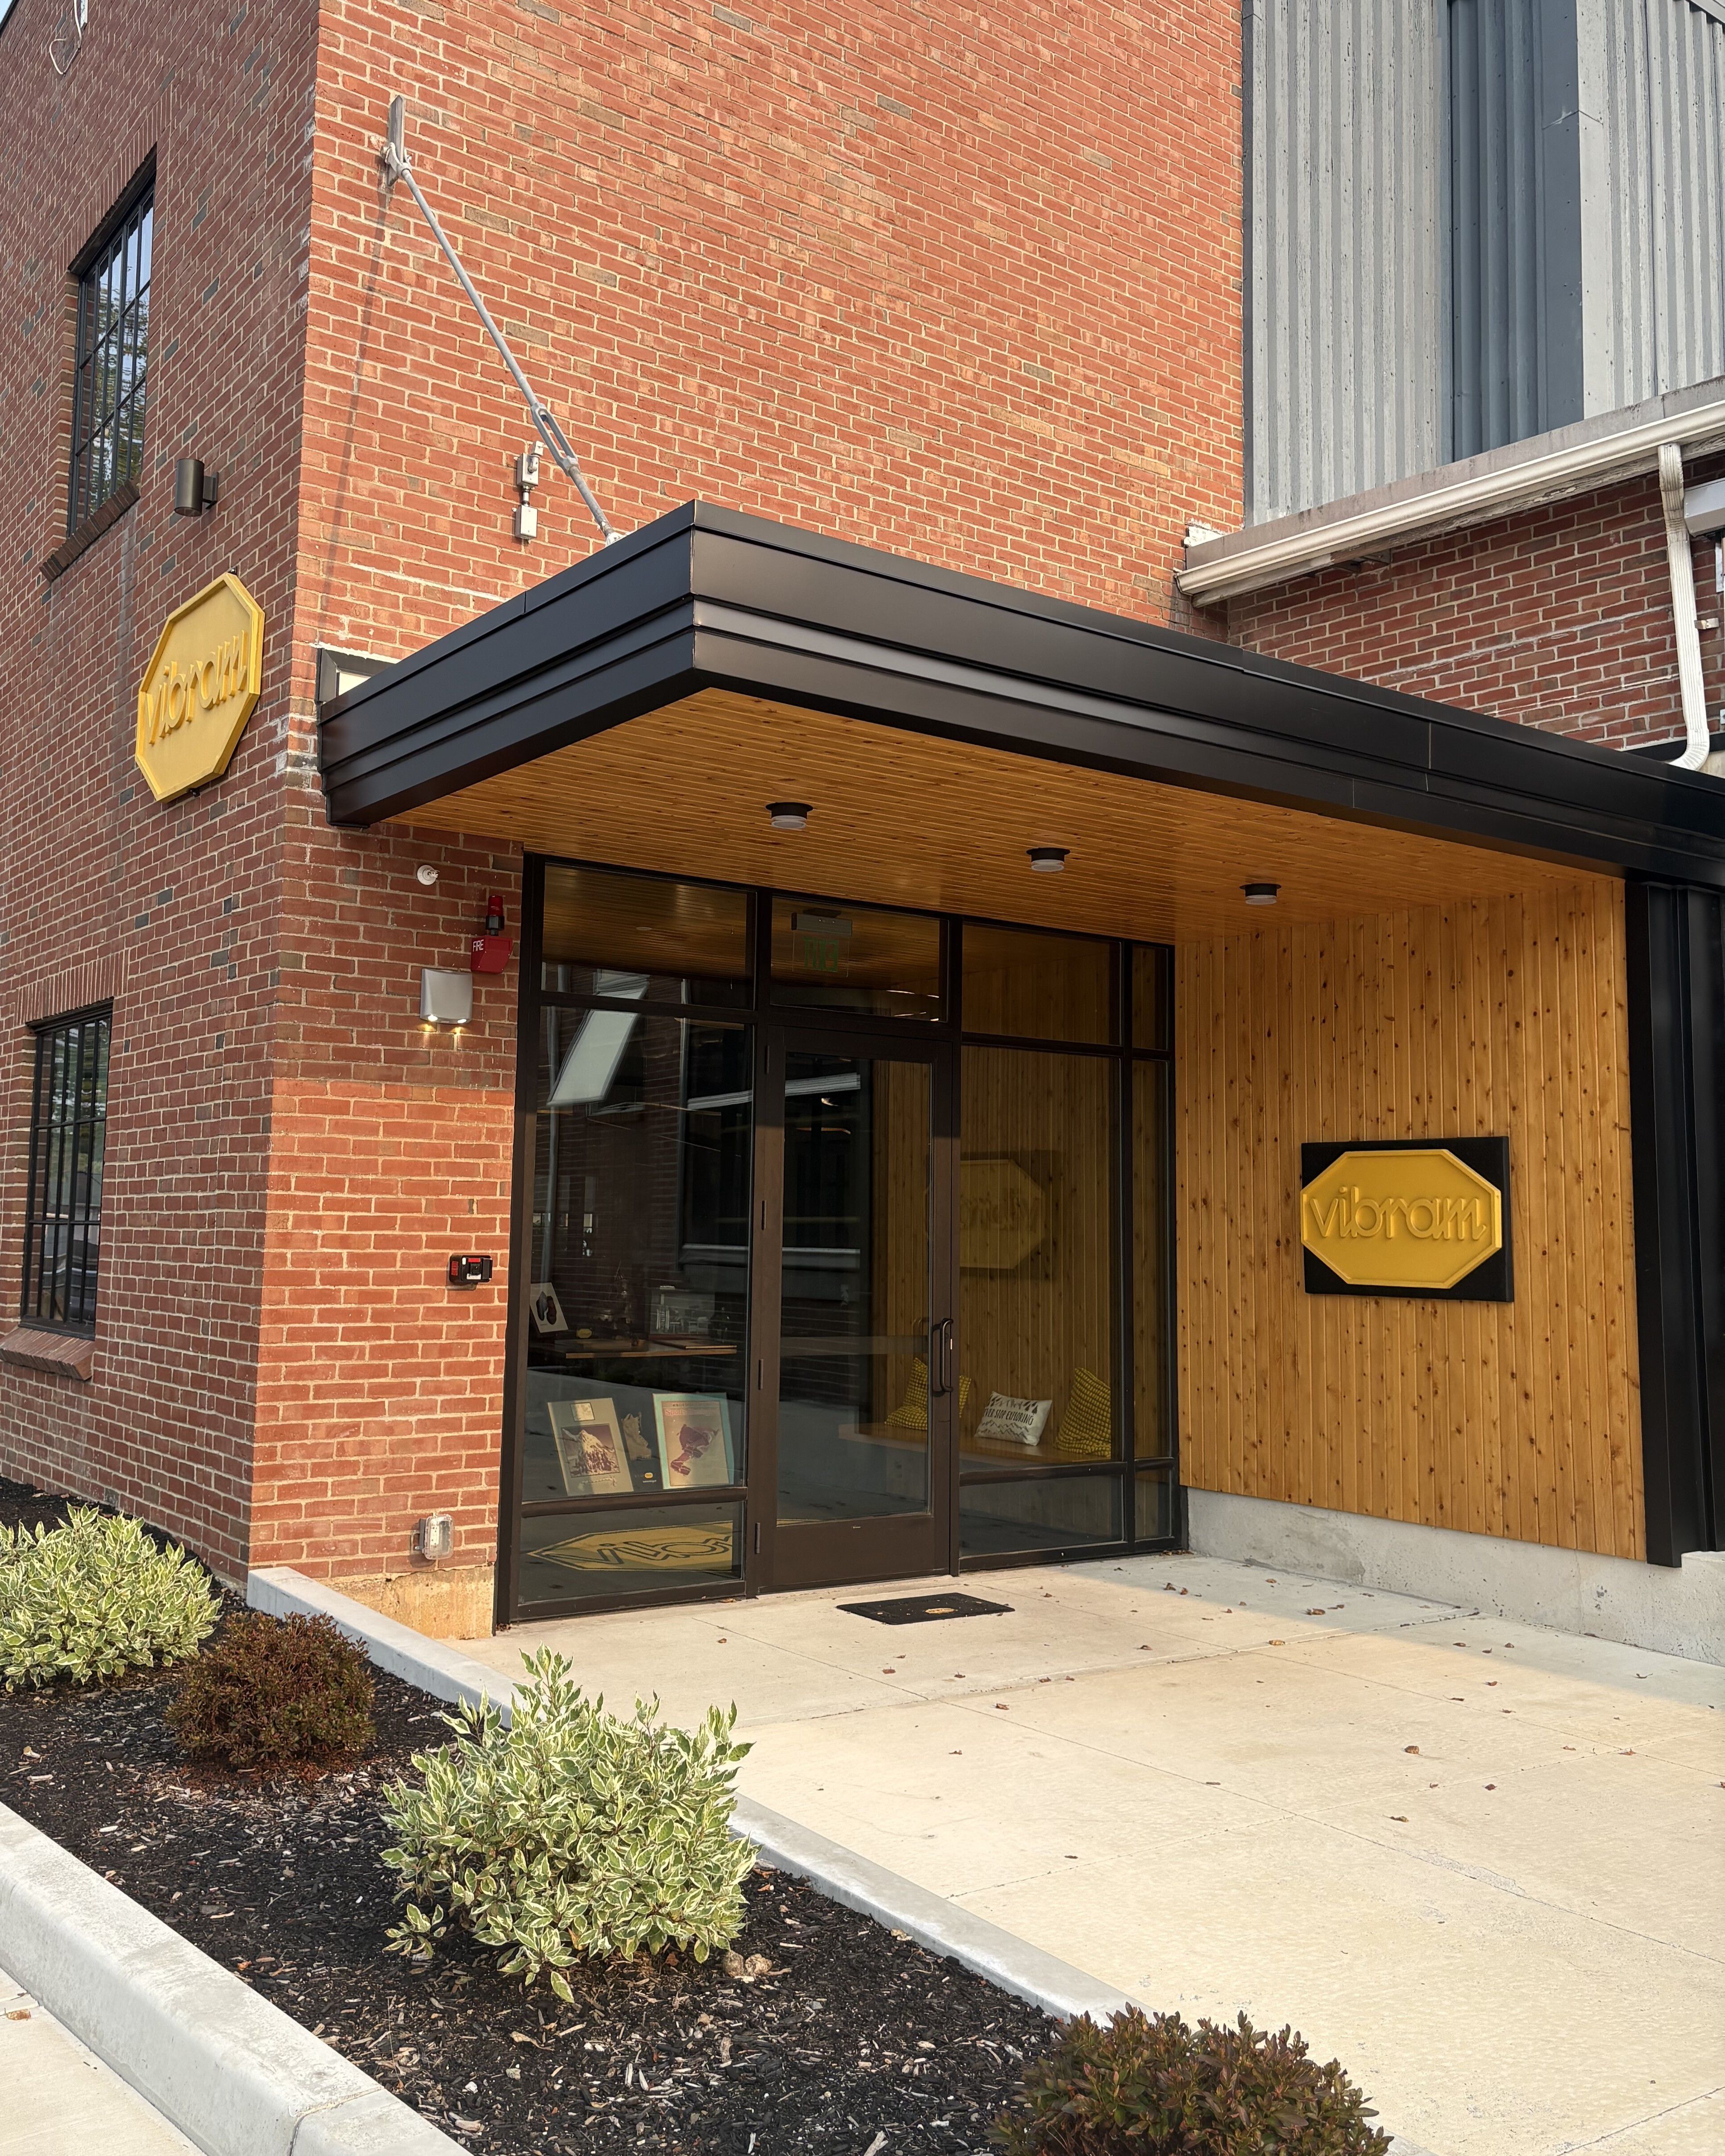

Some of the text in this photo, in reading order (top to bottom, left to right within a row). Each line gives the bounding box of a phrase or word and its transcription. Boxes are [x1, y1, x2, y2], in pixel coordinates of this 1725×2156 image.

[145, 630, 247, 746] vibram
[473, 939, 484, 952] FIRE
[1309, 1186, 1487, 1241] vibram
[994, 1409, 1006, 1419] STOP
[1006, 1411, 1034, 1425] EXPLORING
